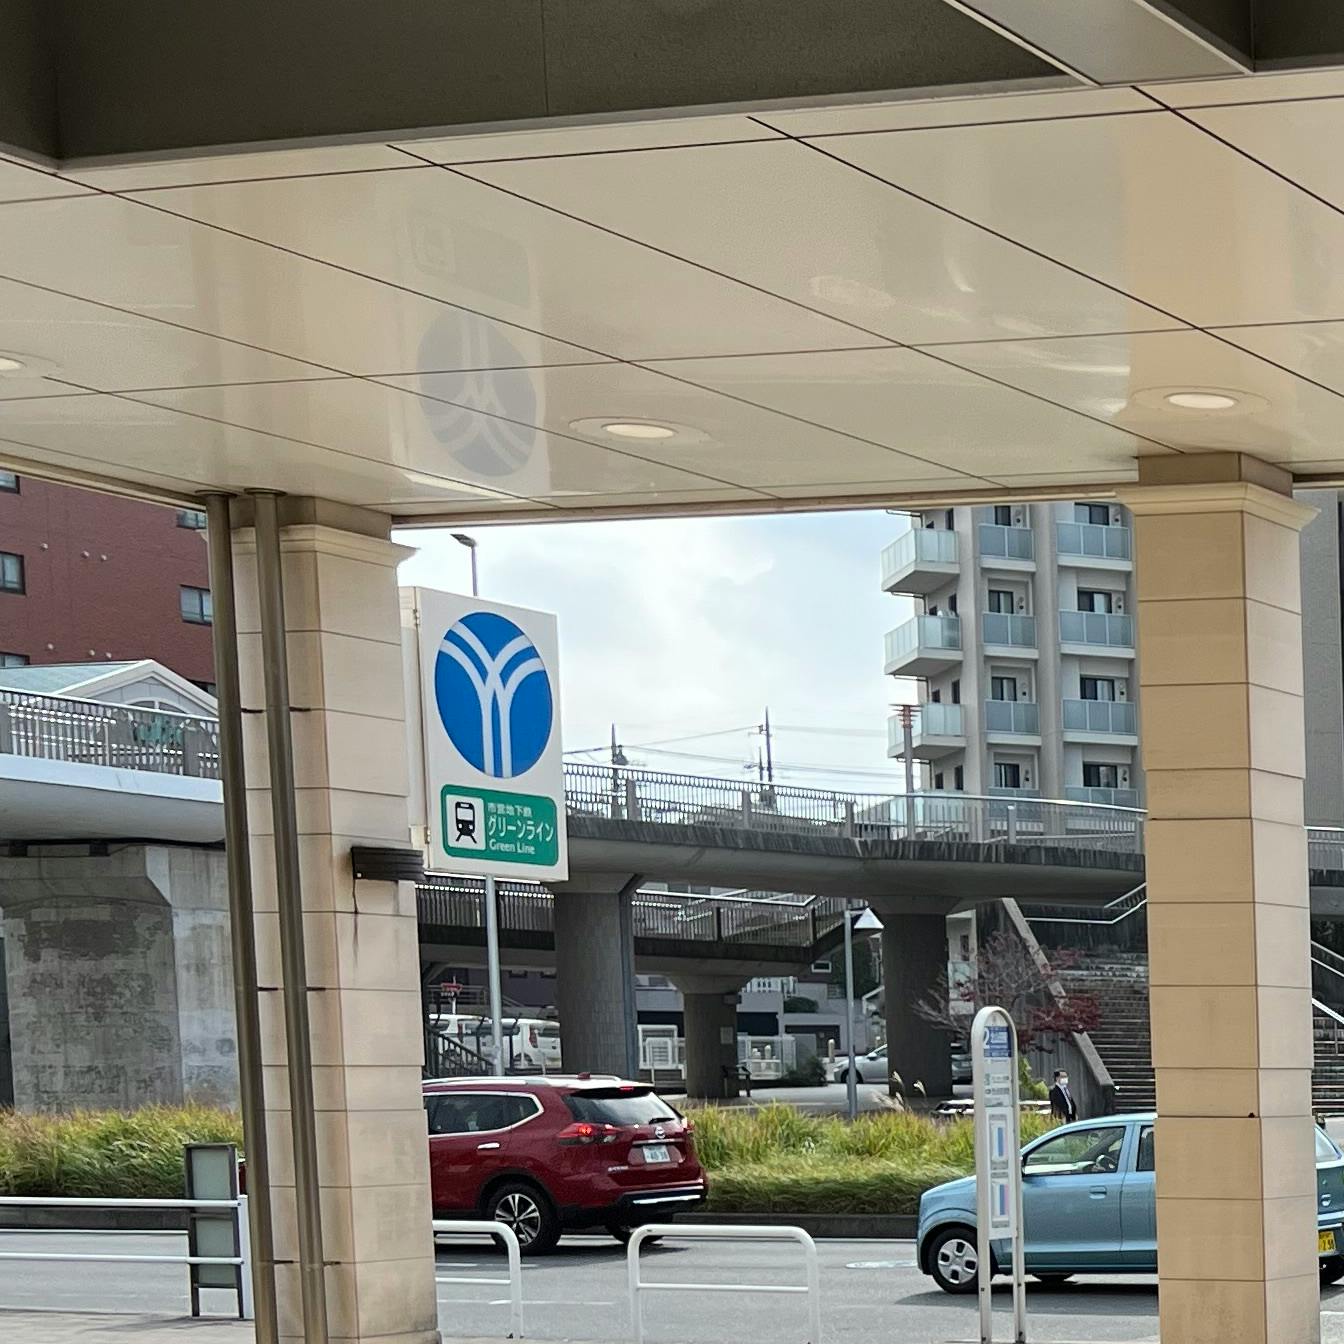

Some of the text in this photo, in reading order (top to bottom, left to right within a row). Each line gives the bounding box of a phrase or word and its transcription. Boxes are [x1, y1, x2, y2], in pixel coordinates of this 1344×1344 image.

[488, 815, 554, 842] グリーンライン
[489, 838, 536, 855] Green Line
